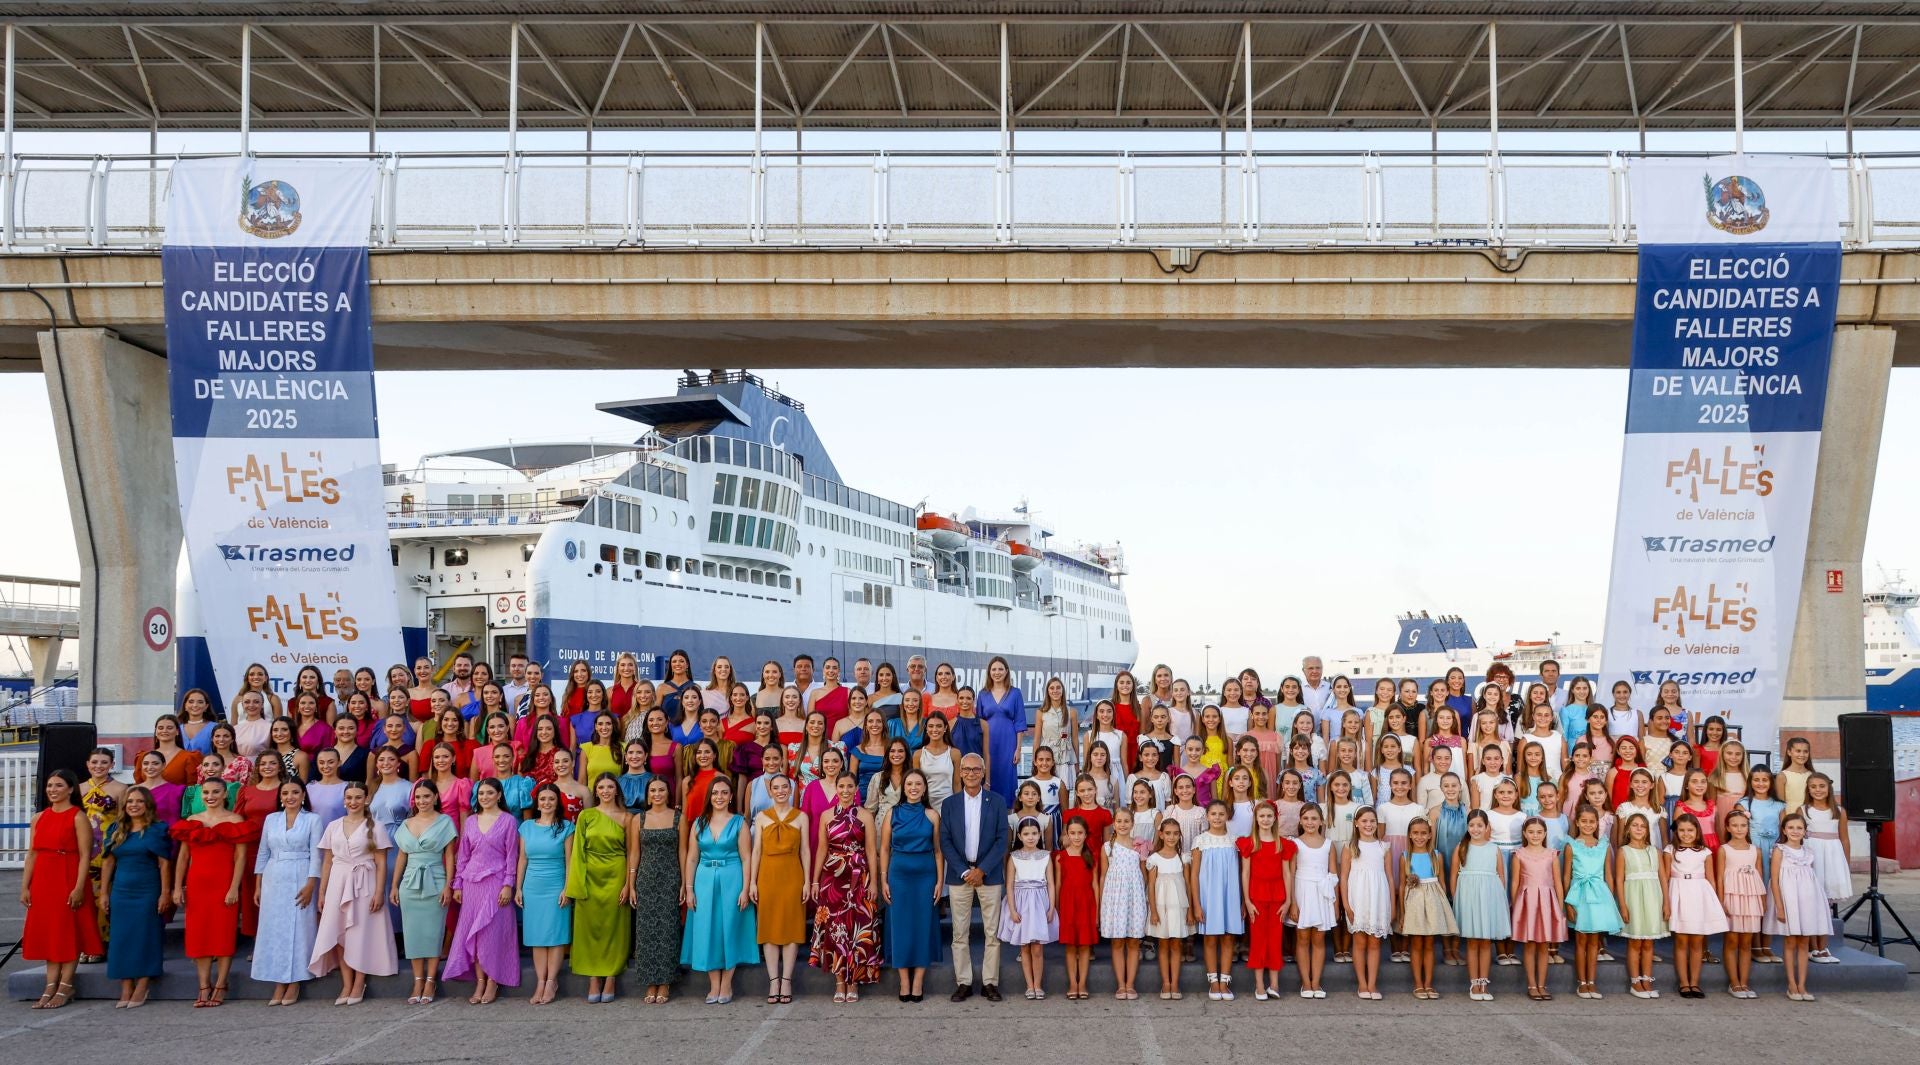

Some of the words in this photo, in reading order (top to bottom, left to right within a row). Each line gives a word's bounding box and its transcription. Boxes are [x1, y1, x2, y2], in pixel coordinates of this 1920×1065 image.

[213, 258, 316, 283] ELECCIÓ
[1689, 253, 1790, 280] ELECCIÓ
[181, 290, 329, 312] CANDIDATES
[335, 291, 352, 312] A
[1653, 287, 1799, 310] CANDIDATES
[1803, 287, 1820, 307] A
[206, 320, 326, 342] FALLERES
[1674, 316, 1792, 338] FALLERES
[218, 350, 317, 371] MAJORS
[1682, 346, 1779, 367] MAJORS
[194, 379, 225, 400] DE
[230, 375, 349, 401] VALÈNCIA
[1652, 376, 1682, 396] DE
[1690, 370, 1802, 396] VALÈNCIA
[246, 409, 298, 429] 2025
[1698, 404, 1749, 424] 2025
[226, 450, 341, 511] FALLES
[1665, 444, 1774, 503] FALLES
[247, 516, 265, 529] de
[268, 516, 329, 529] València
[1676, 508, 1693, 521] de
[1697, 508, 1755, 521] València
[244, 543, 355, 562] Trasmed
[1667, 535, 1776, 553] Trasmed
[456, 573, 461, 583] 3
[247, 590, 359, 648] FALLES
[1652, 582, 1758, 639] FALLES
[150, 623, 167, 636] 30
[270, 652, 287, 664] de
[289, 652, 348, 664] València
[558, 649, 590, 661] CIUDAD
[595, 650, 606, 661] DE
[1664, 643, 1681, 656] de
[1685, 643, 1740, 656] València
